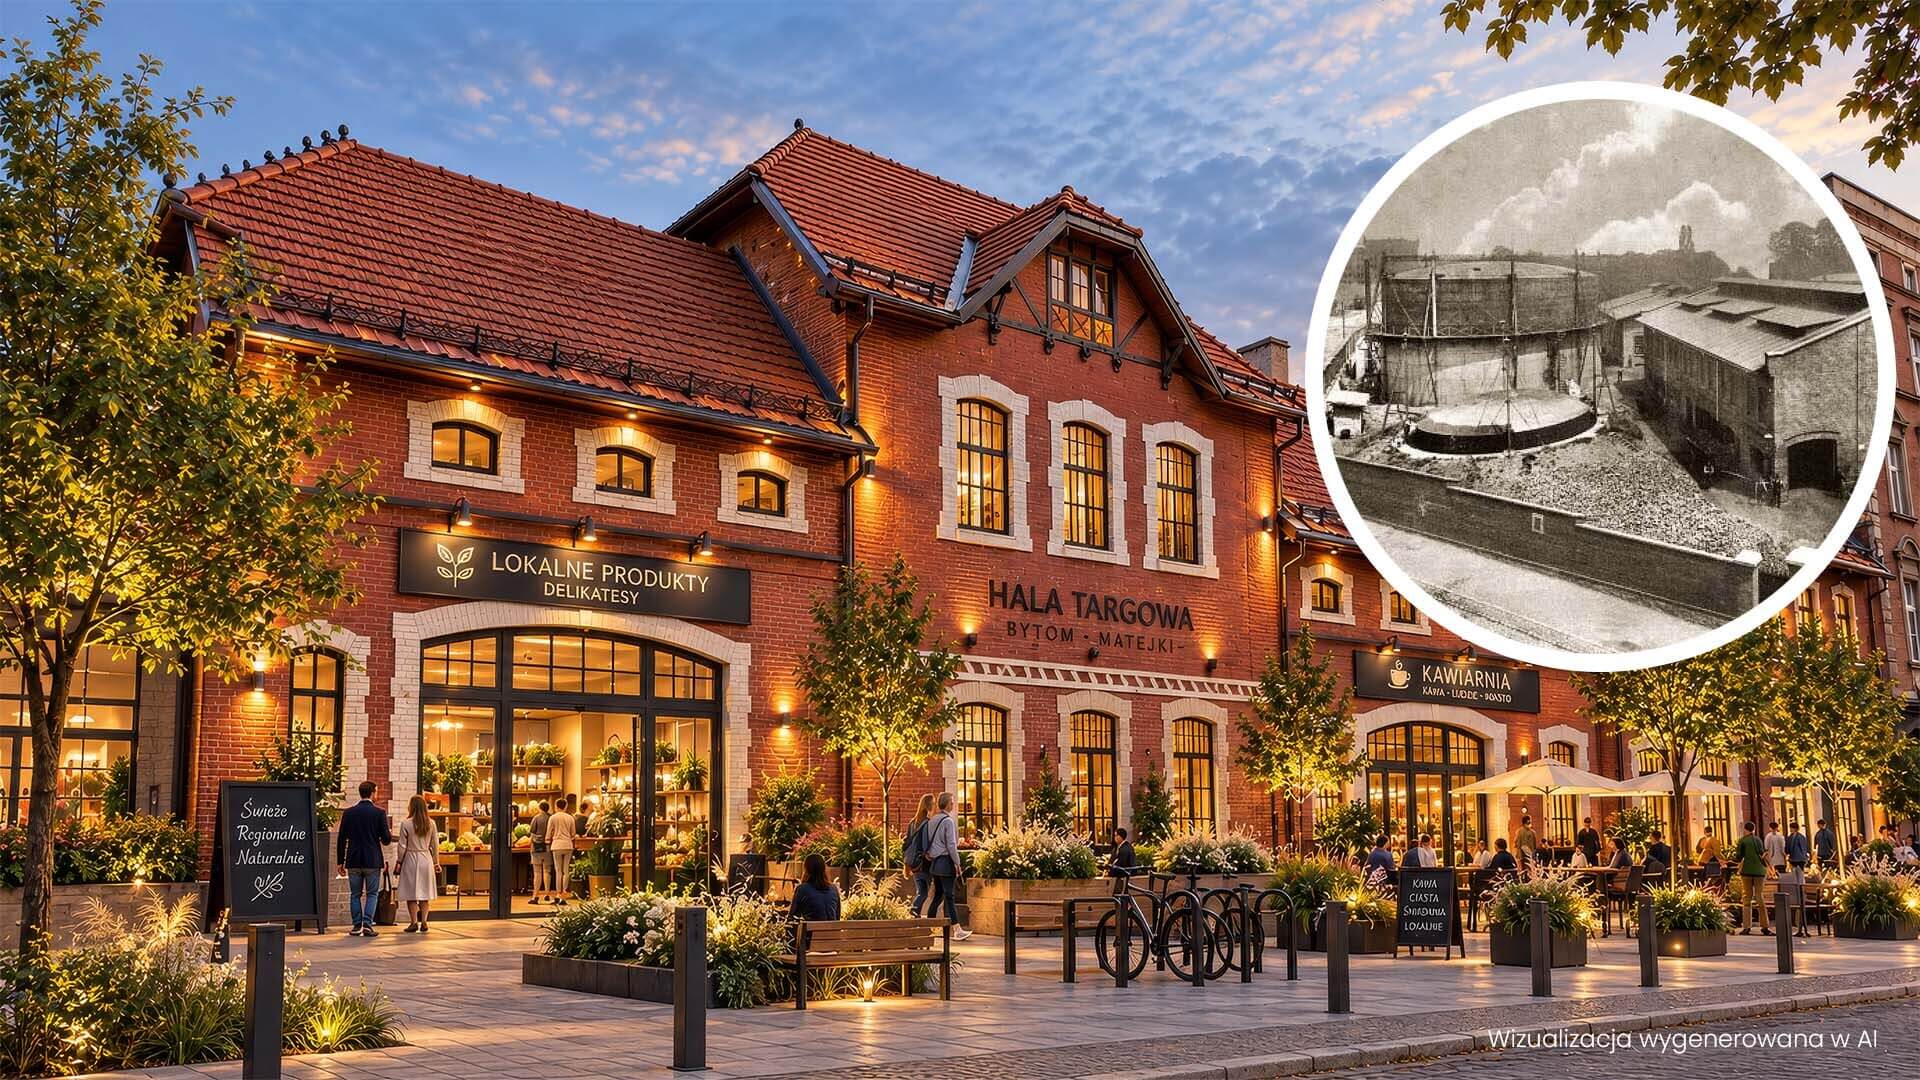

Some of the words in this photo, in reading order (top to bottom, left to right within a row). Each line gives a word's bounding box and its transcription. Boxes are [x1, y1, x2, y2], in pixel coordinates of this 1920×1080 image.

[492, 552, 593, 581] LOKALNE
[602, 565, 709, 592] PRODUKTY
[544, 582, 639, 605] DELIKATESY
[989, 580, 1063, 615] HALA
[1072, 591, 1194, 631] TARGOWA
[1007, 621, 1074, 642] BYTOM
[1422, 665, 1511, 690] KAWIARNIA
[241, 797, 288, 819] Świeże
[237, 825, 306, 847] Regionalne
[235, 849, 305, 865] Naturalnie
